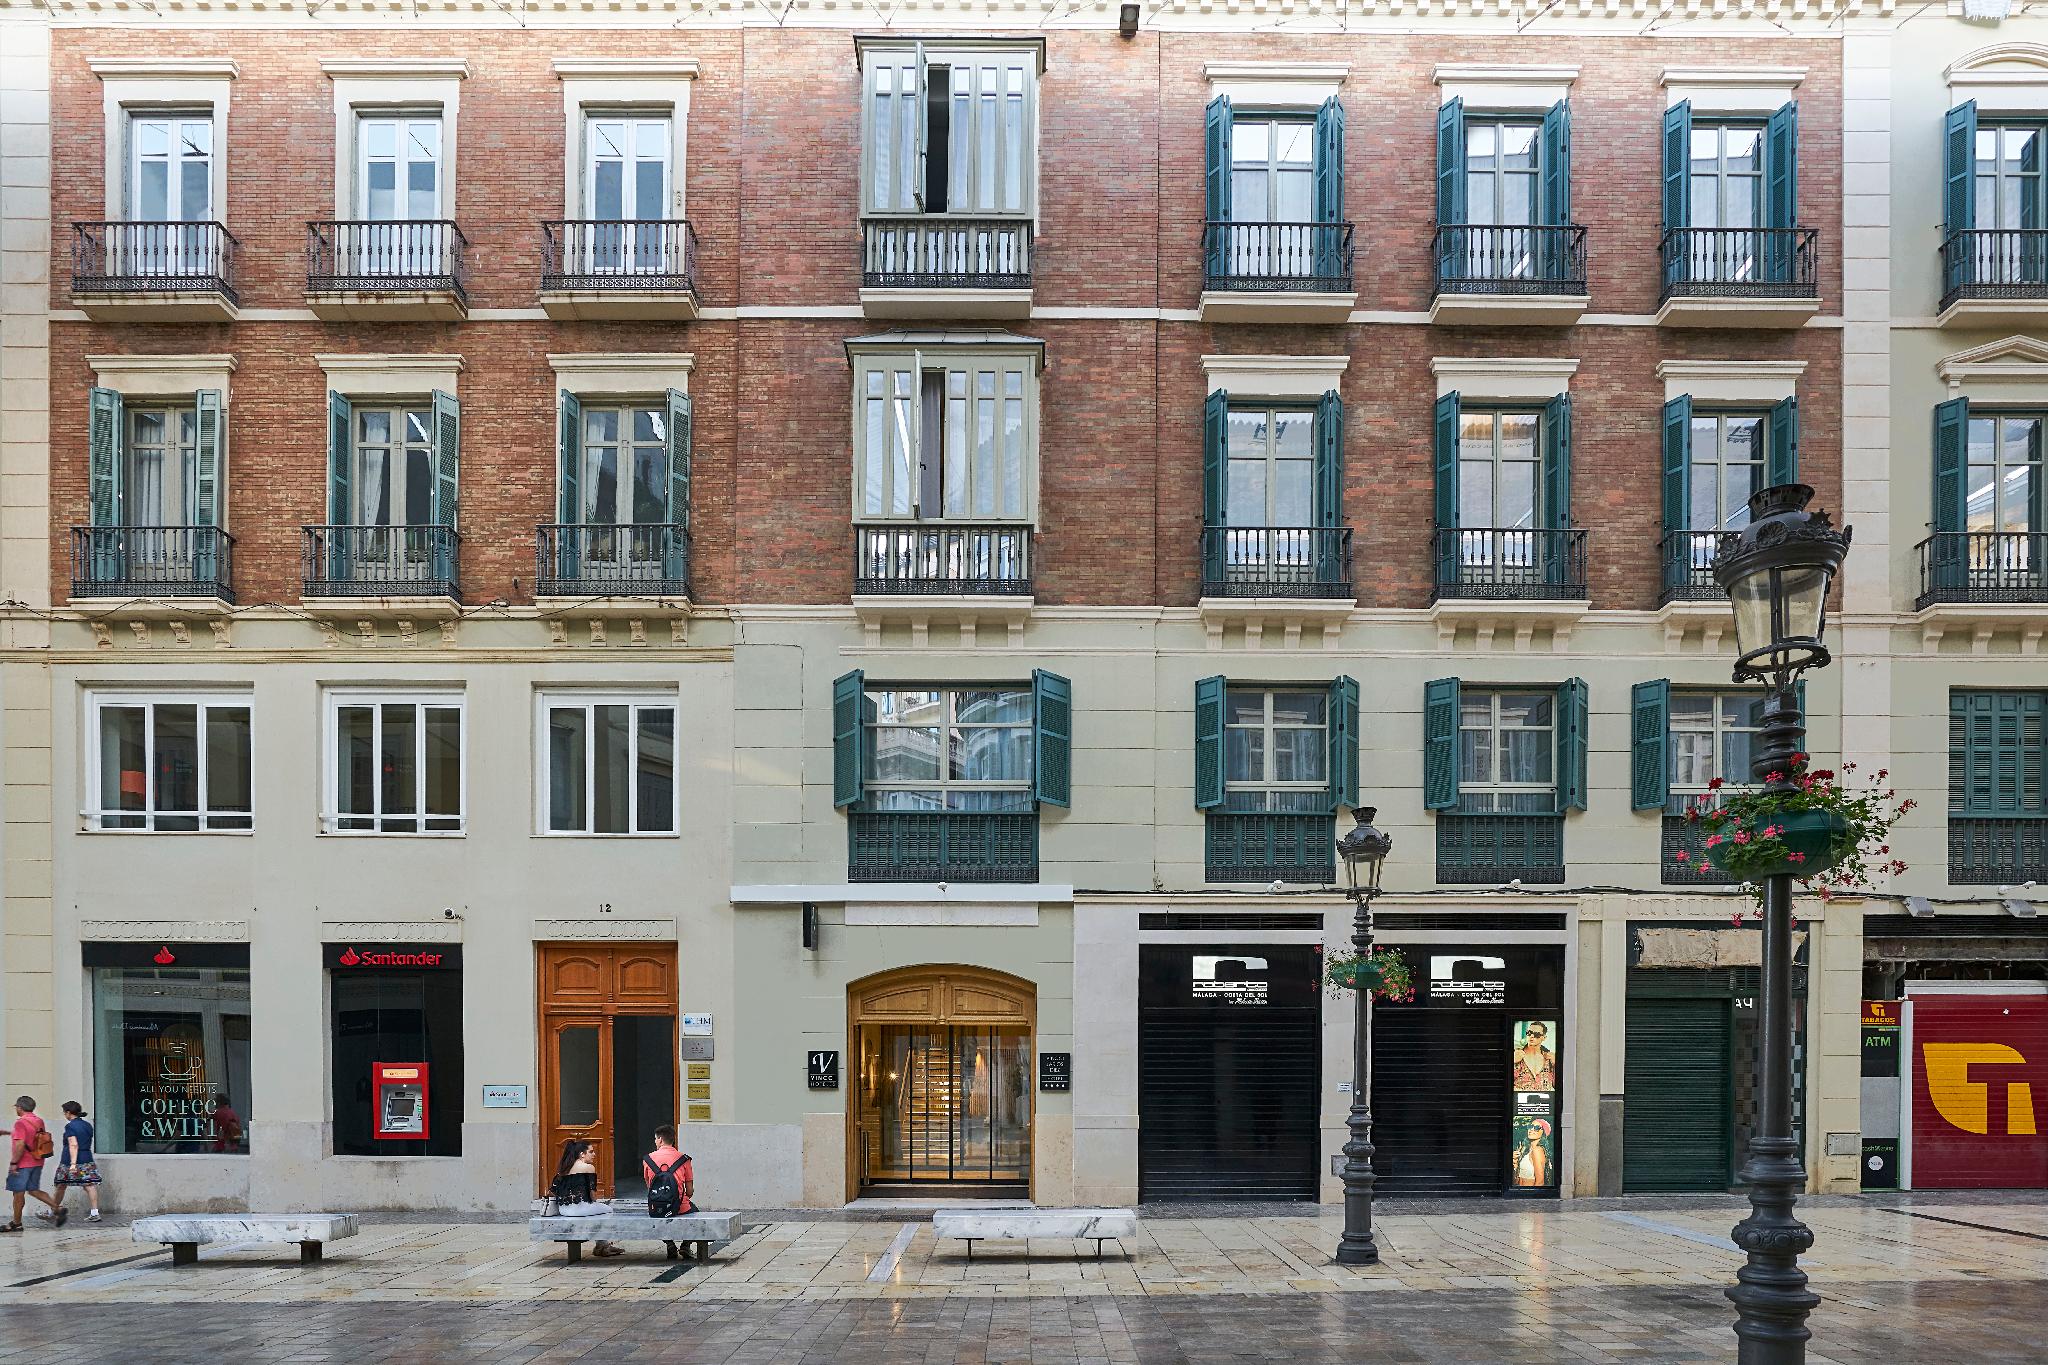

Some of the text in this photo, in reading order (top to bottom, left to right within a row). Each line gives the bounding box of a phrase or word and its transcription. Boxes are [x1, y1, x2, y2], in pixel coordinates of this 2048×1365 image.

[599, 903, 612, 913] 12
[361, 951, 443, 965] Santander
[1865, 1036, 1892, 1047] ATM
[140, 1085, 217, 1094] ALL YOU NEED IS
